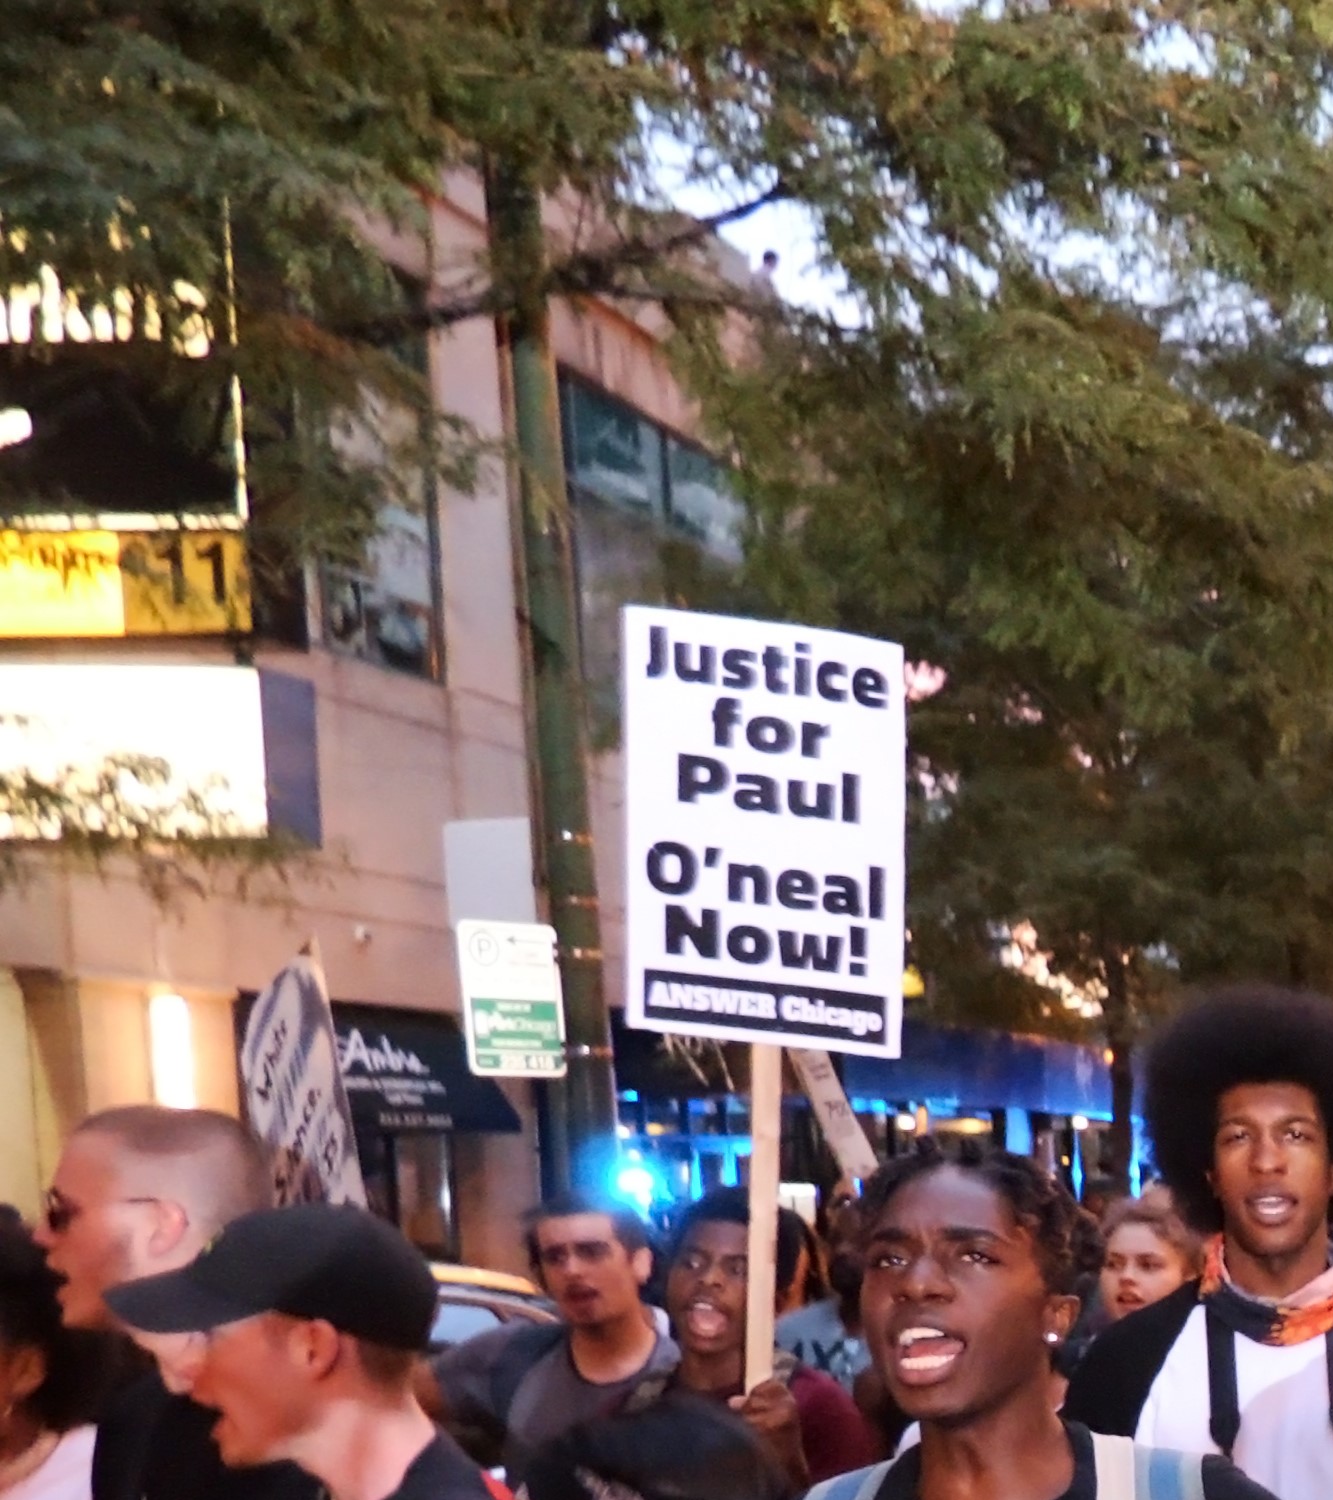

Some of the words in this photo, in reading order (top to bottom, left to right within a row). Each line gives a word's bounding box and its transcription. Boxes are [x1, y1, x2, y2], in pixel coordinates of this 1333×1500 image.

[646, 625, 889, 709] Justice
[712, 697, 831, 759] for
[677, 753, 861, 824] Paul
[647, 840, 886, 921] O'neal
[665, 904, 869, 978] Now!
[649, 980, 777, 1020] ANSWER
[781, 994, 882, 1036] Chicago
